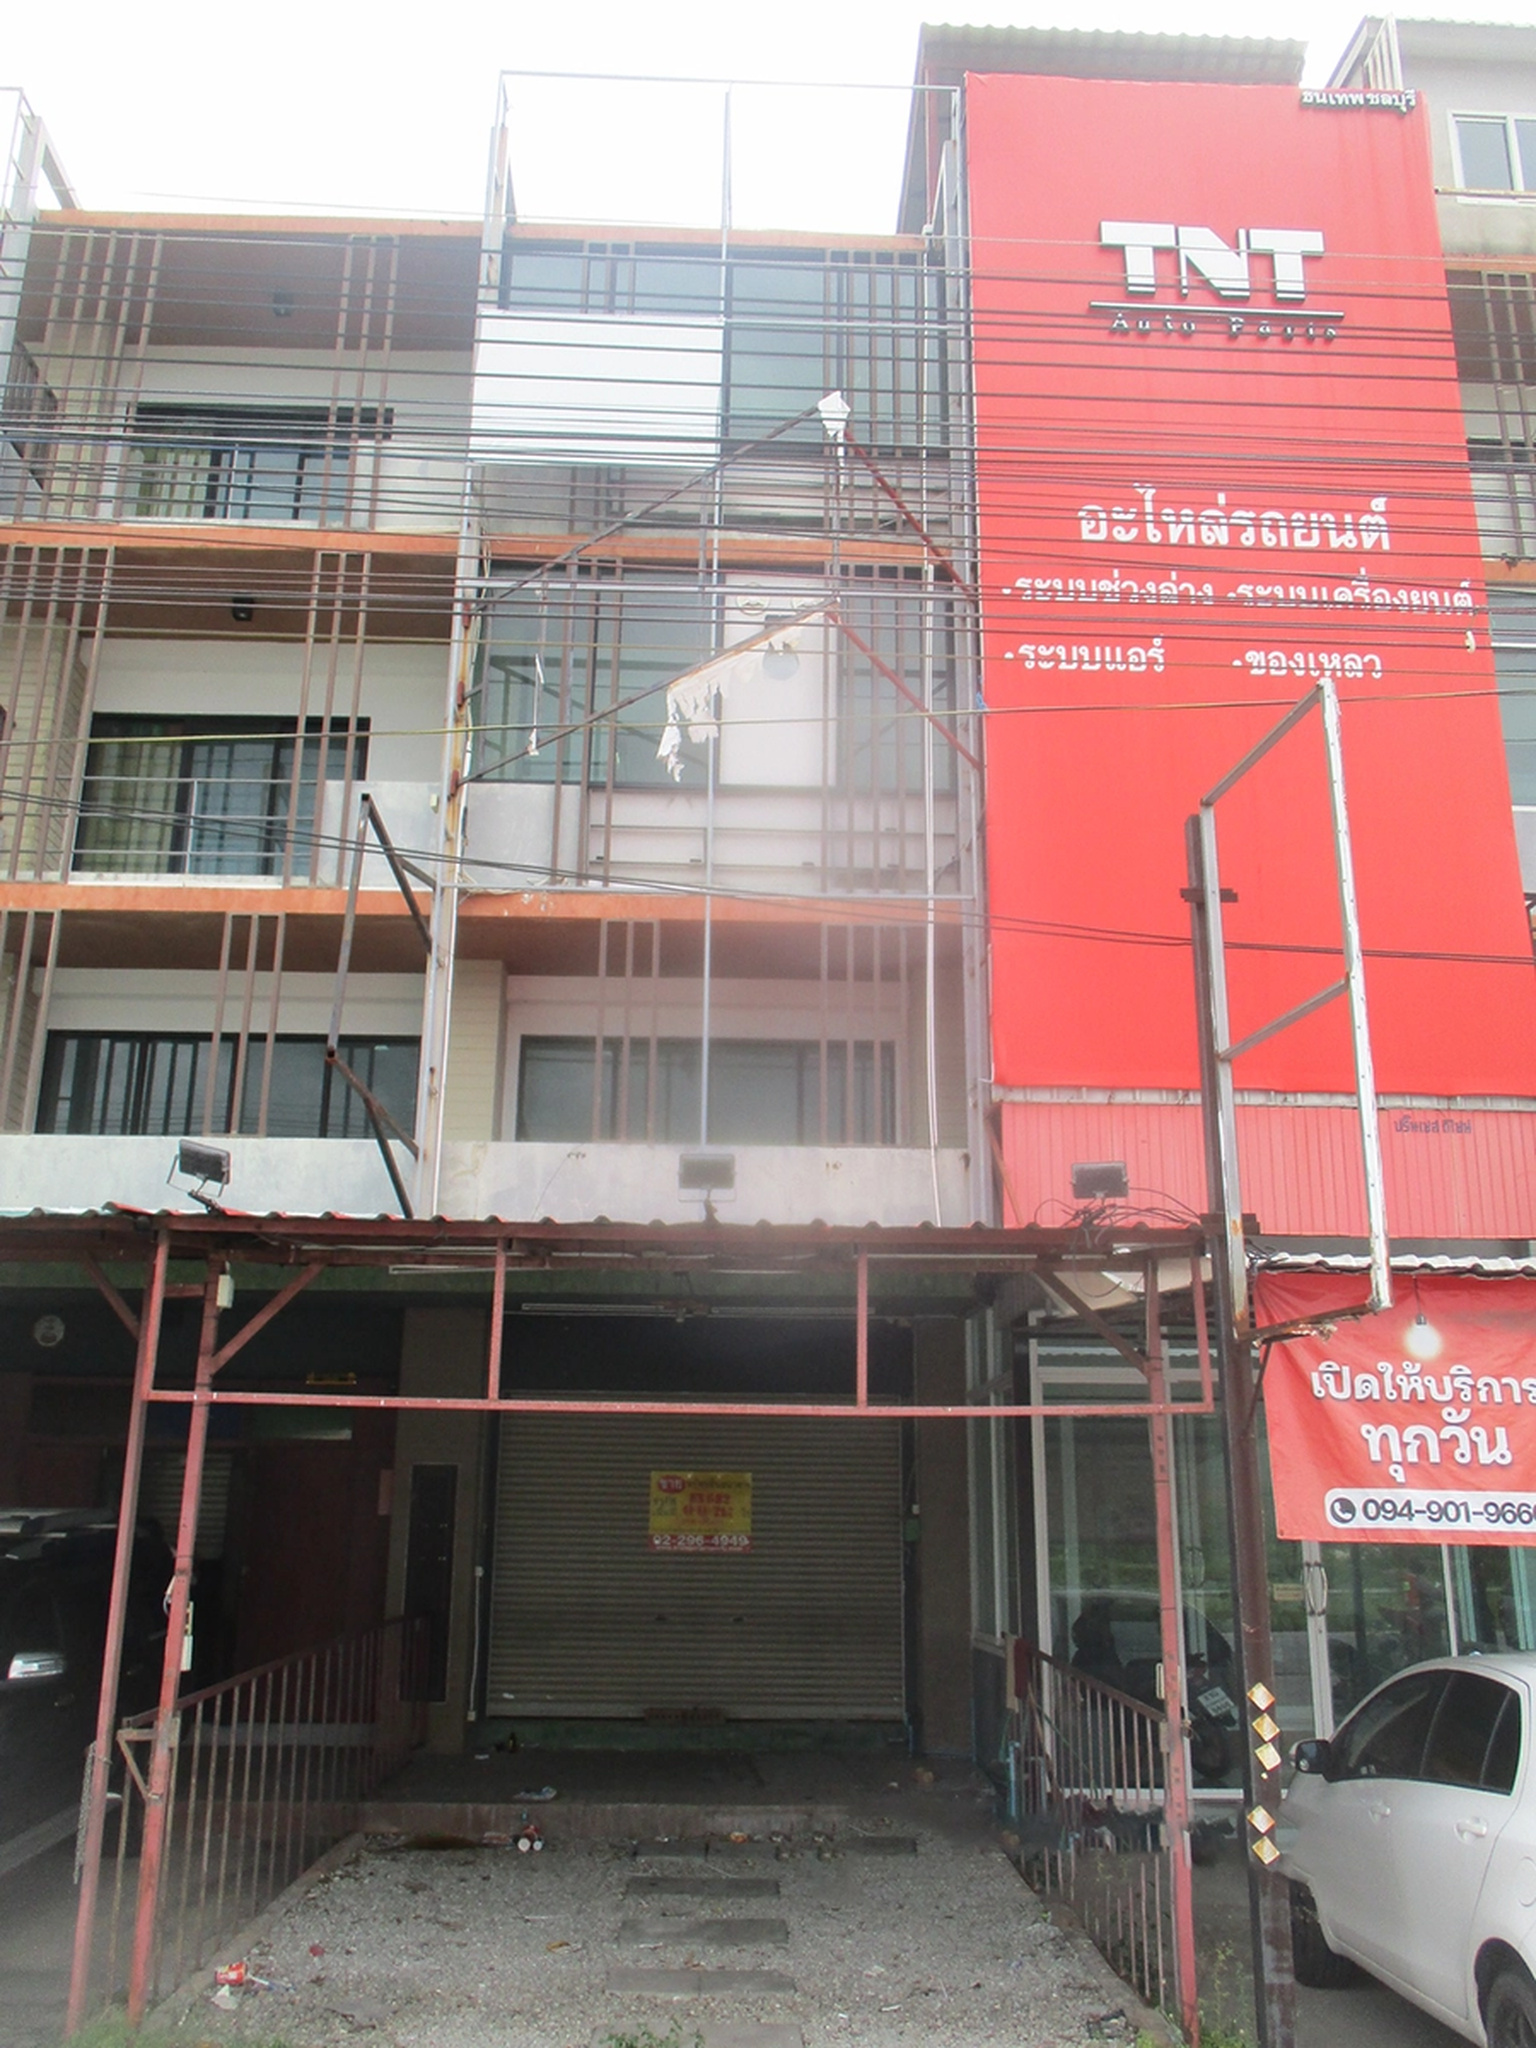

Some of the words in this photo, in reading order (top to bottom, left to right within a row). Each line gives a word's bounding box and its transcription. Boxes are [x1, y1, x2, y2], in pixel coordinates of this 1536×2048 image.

[1100, 221, 1326, 303] TNT
[1078, 483, 1391, 551] อะไหล่รถยนต์
[1310, 1361, 1536, 1404] เปิดให้บริการ
[1360, 1407, 1512, 1483] ทุกวัน
[1362, 1497, 1536, 1525] 094-901-966
